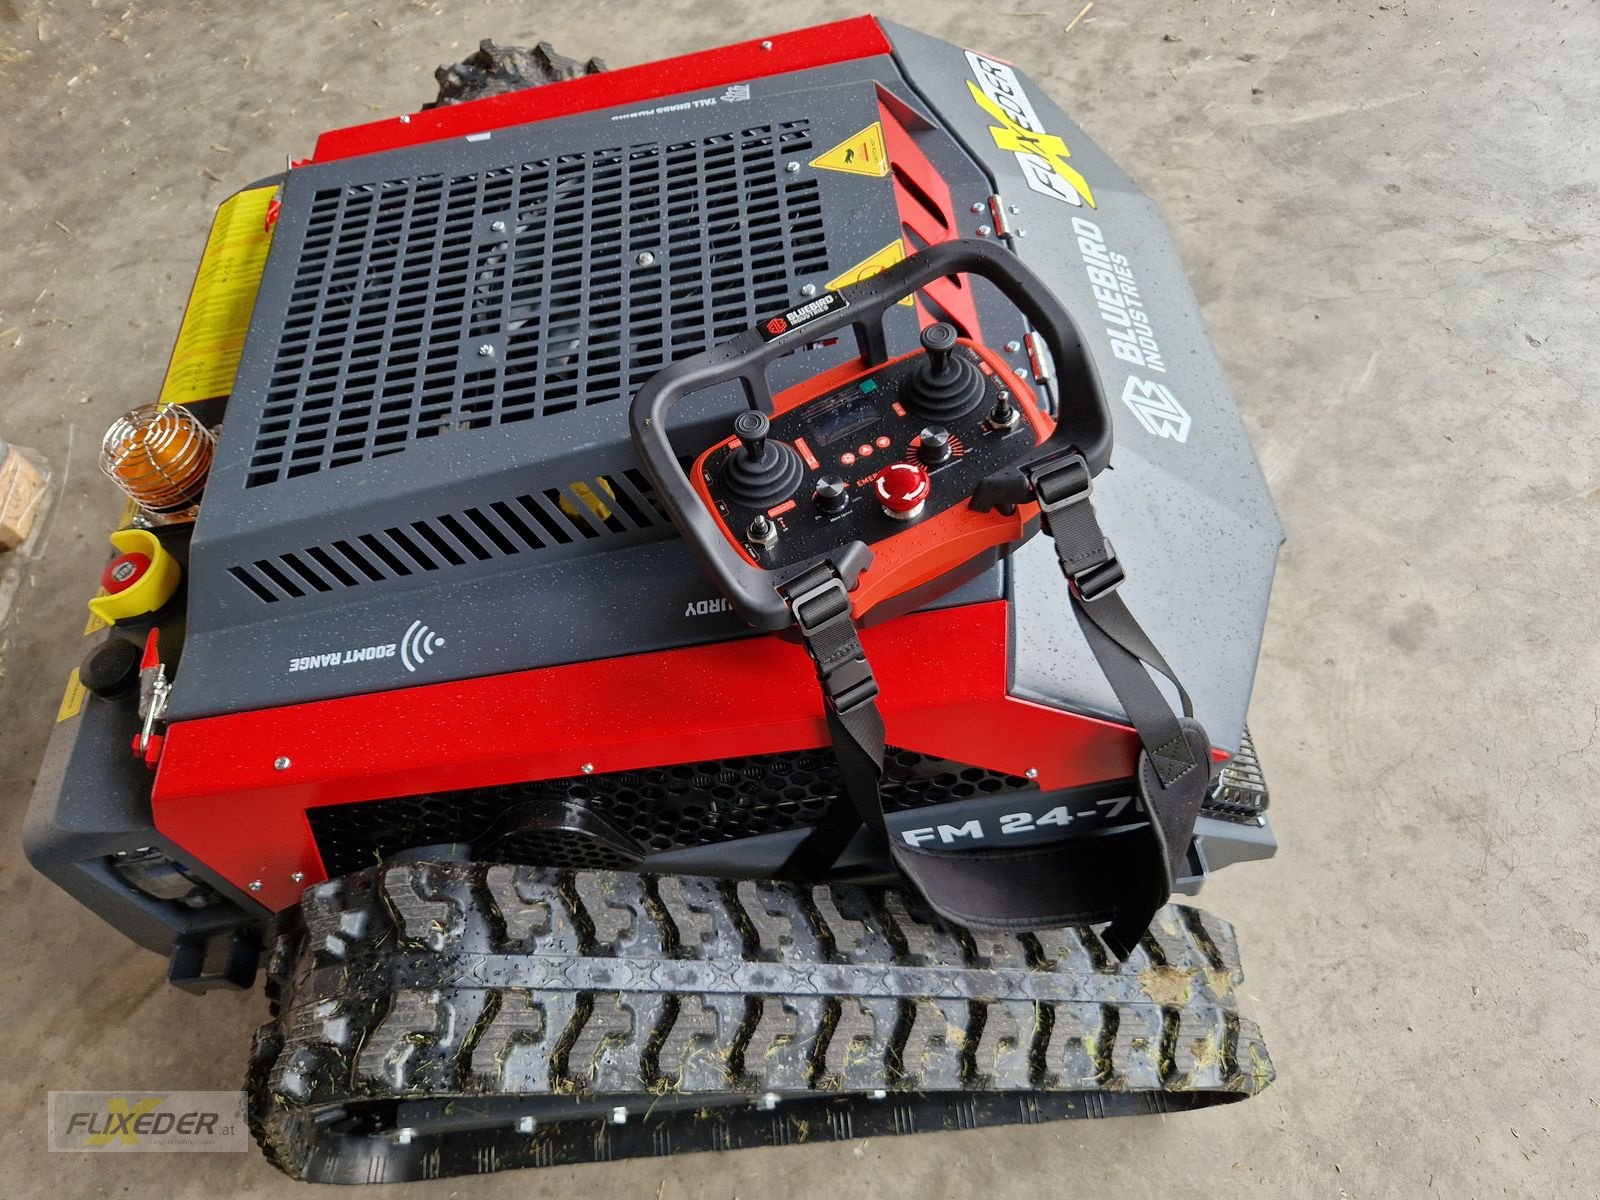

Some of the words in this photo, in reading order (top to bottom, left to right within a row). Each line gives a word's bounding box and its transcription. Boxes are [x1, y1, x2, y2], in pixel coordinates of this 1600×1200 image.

[975, 56, 1067, 198] FLIXEDER
[785, 294, 834, 321] BLUEBIRD
[1071, 216, 1146, 366] BLUEBIRD
[790, 305, 829, 326] INDUSTRIES
[1109, 251, 1167, 373] INDUSTRIES
[289, 652, 342, 672] RANGE
[343, 643, 397, 664] 200MT
[901, 820, 985, 848] FM
[999, 796, 1145, 835] 24-7
